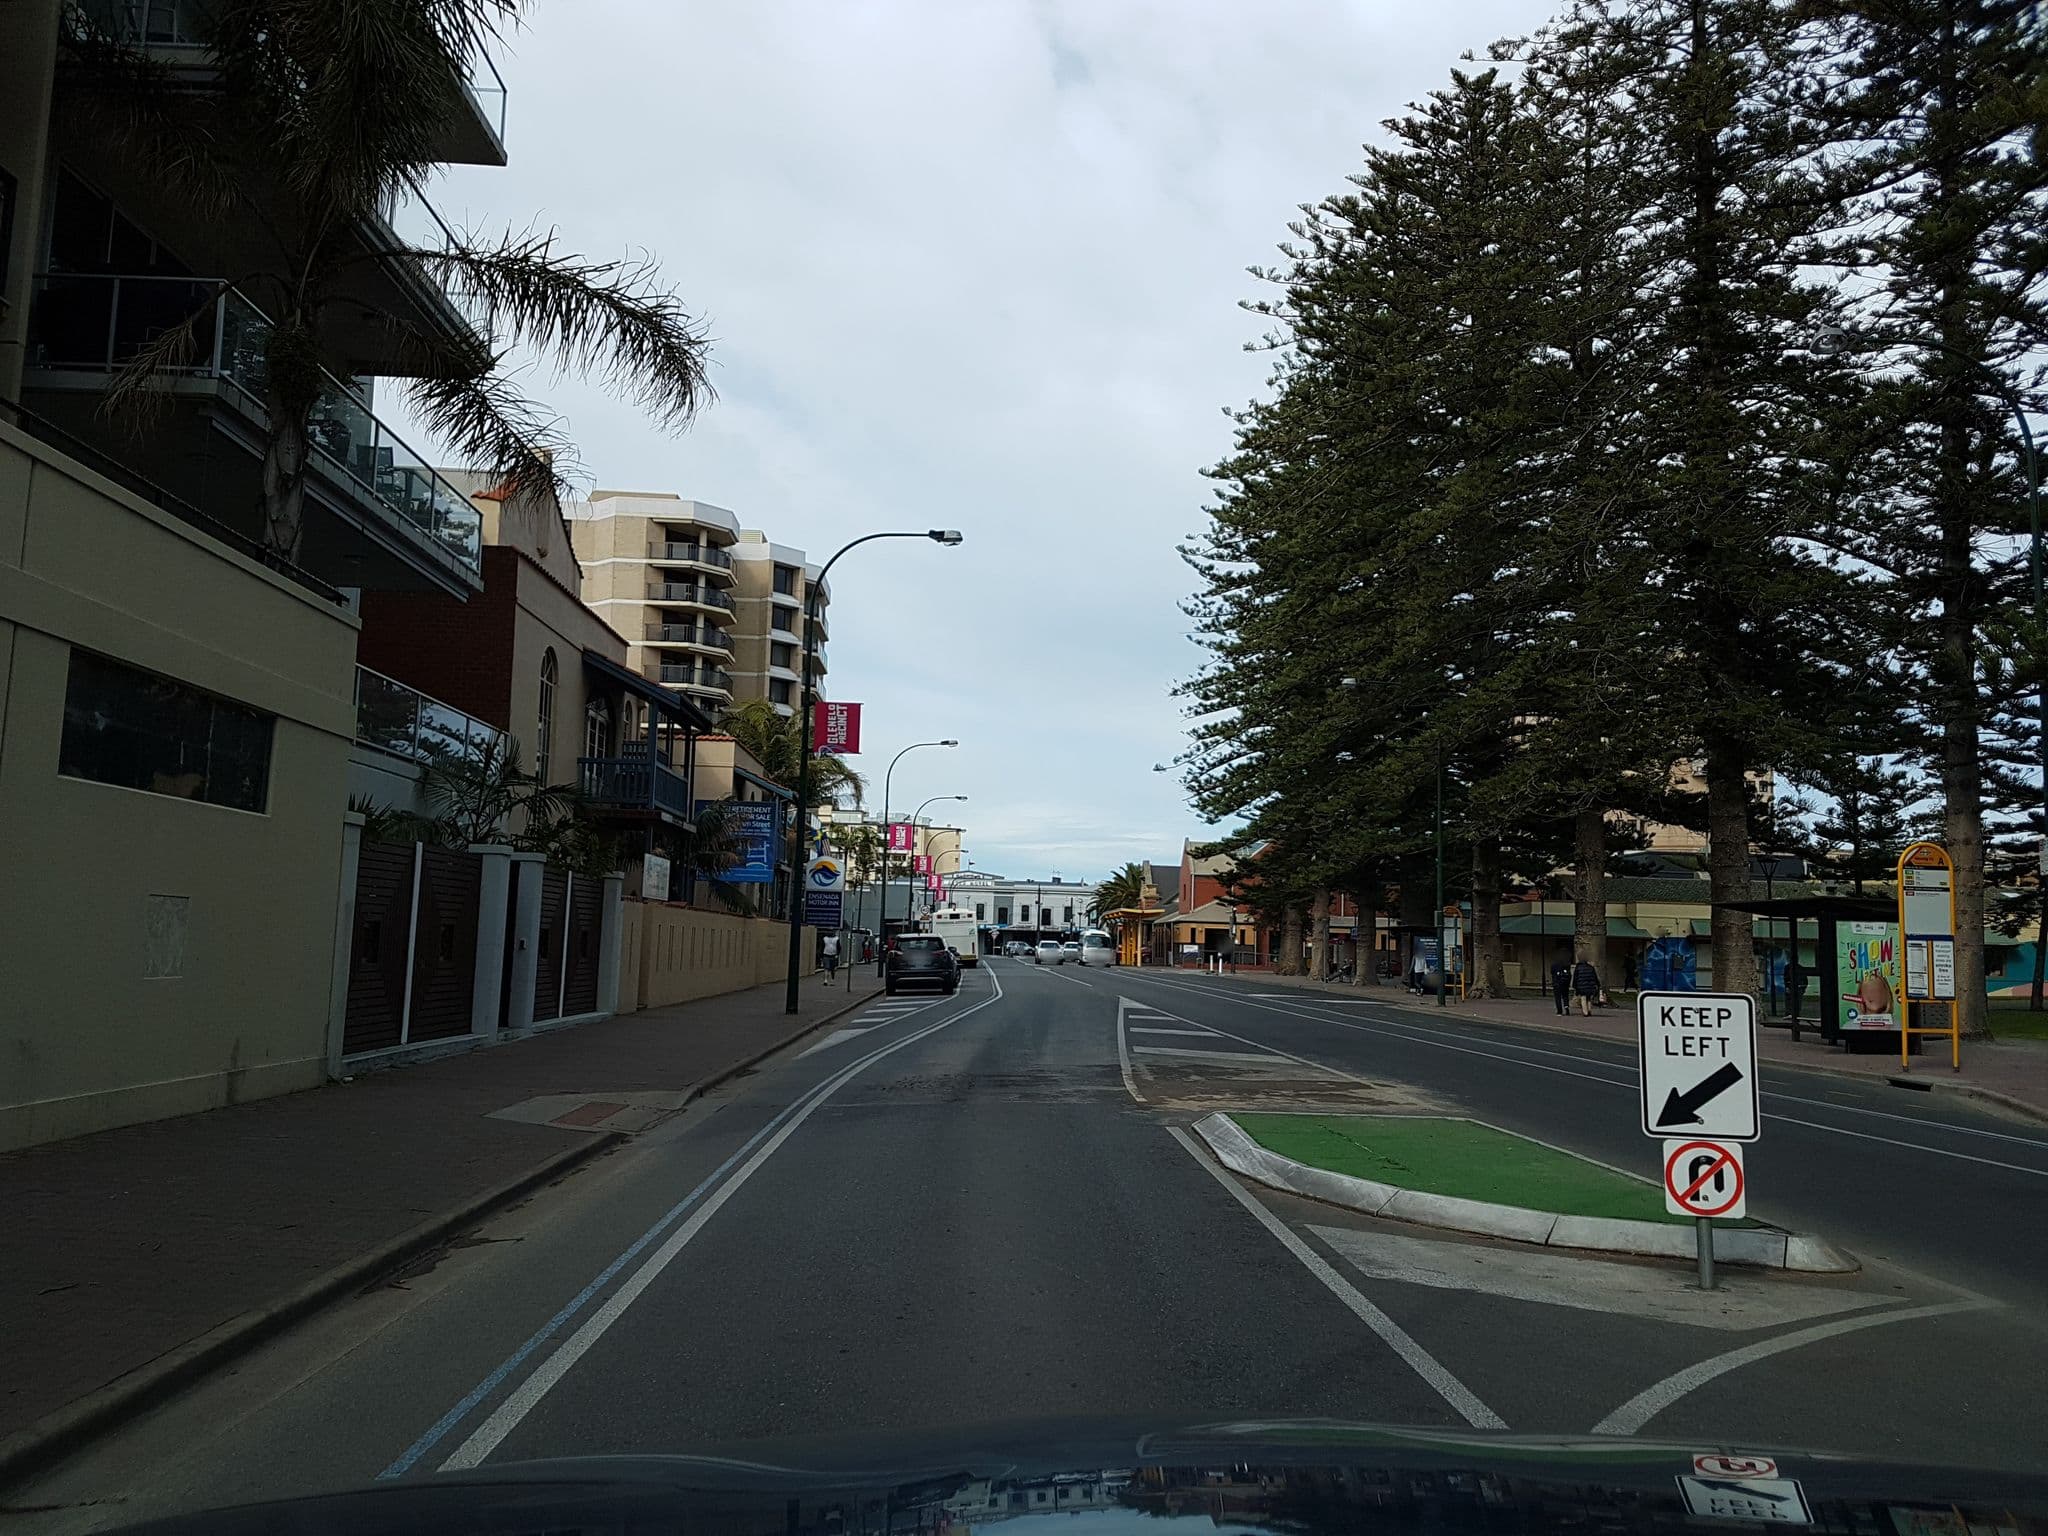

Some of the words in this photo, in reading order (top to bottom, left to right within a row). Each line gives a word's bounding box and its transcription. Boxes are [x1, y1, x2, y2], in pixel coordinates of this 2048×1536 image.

[836, 703, 848, 745] PRECINCT
[751, 820, 771, 828] Street
[756, 813, 771, 821] SALE
[1937, 857, 1945, 866] A
[1849, 936, 1893, 970] SHOW
[1660, 1006, 1732, 1028] KEEP
[1664, 1035, 1730, 1058] LEFT
